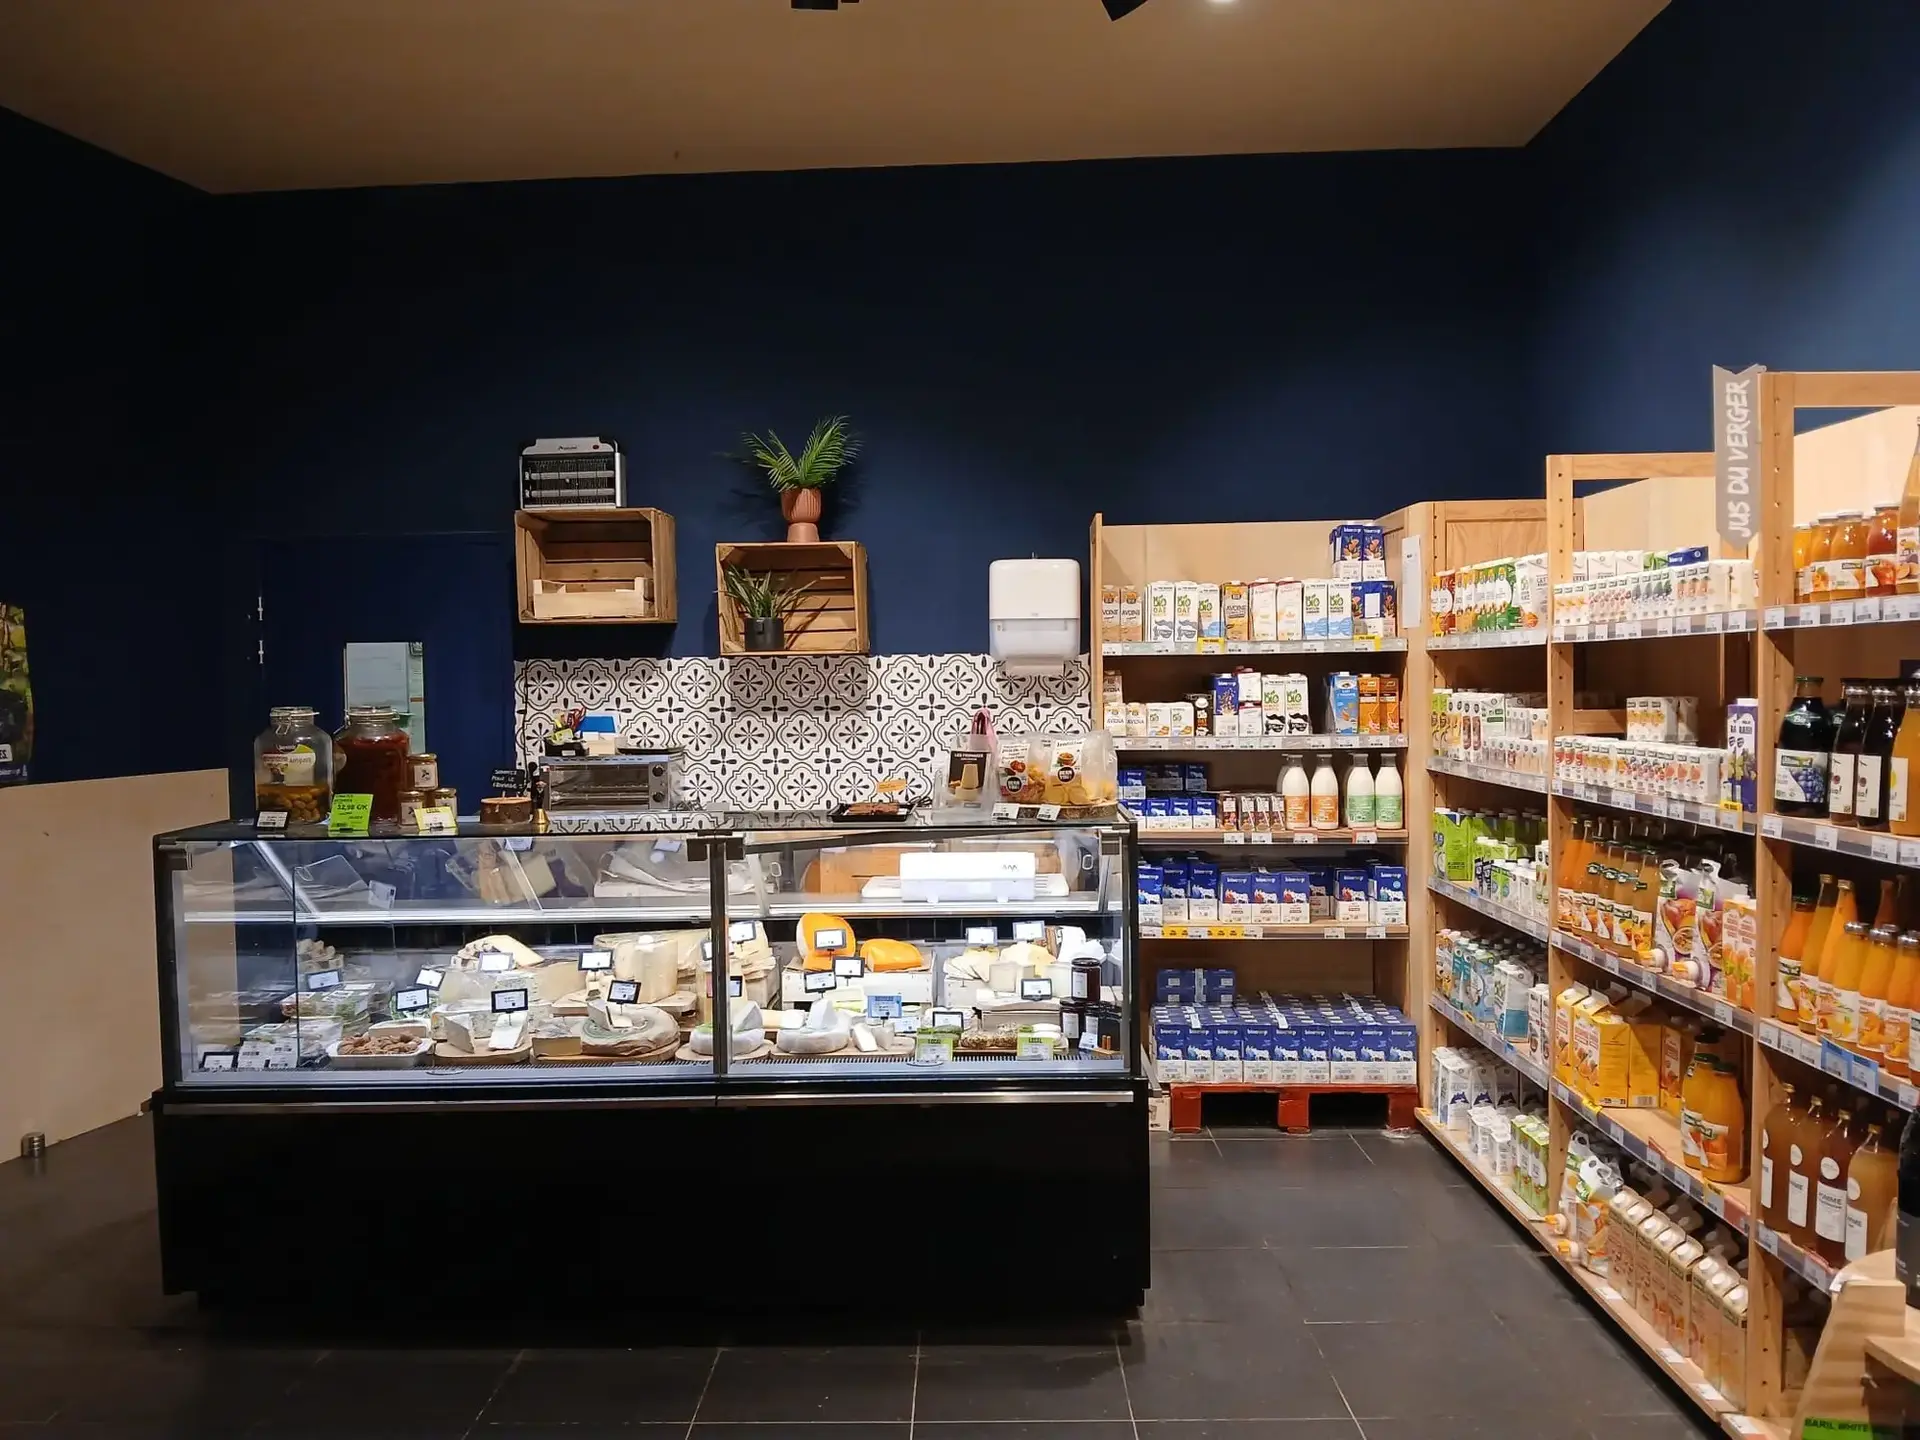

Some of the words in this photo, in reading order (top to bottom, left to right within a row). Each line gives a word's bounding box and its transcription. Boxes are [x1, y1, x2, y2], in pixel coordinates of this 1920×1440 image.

[1725, 379, 1751, 465] VERGER
[1727, 466, 1749, 496] DU
[1727, 501, 1751, 538] JUS
